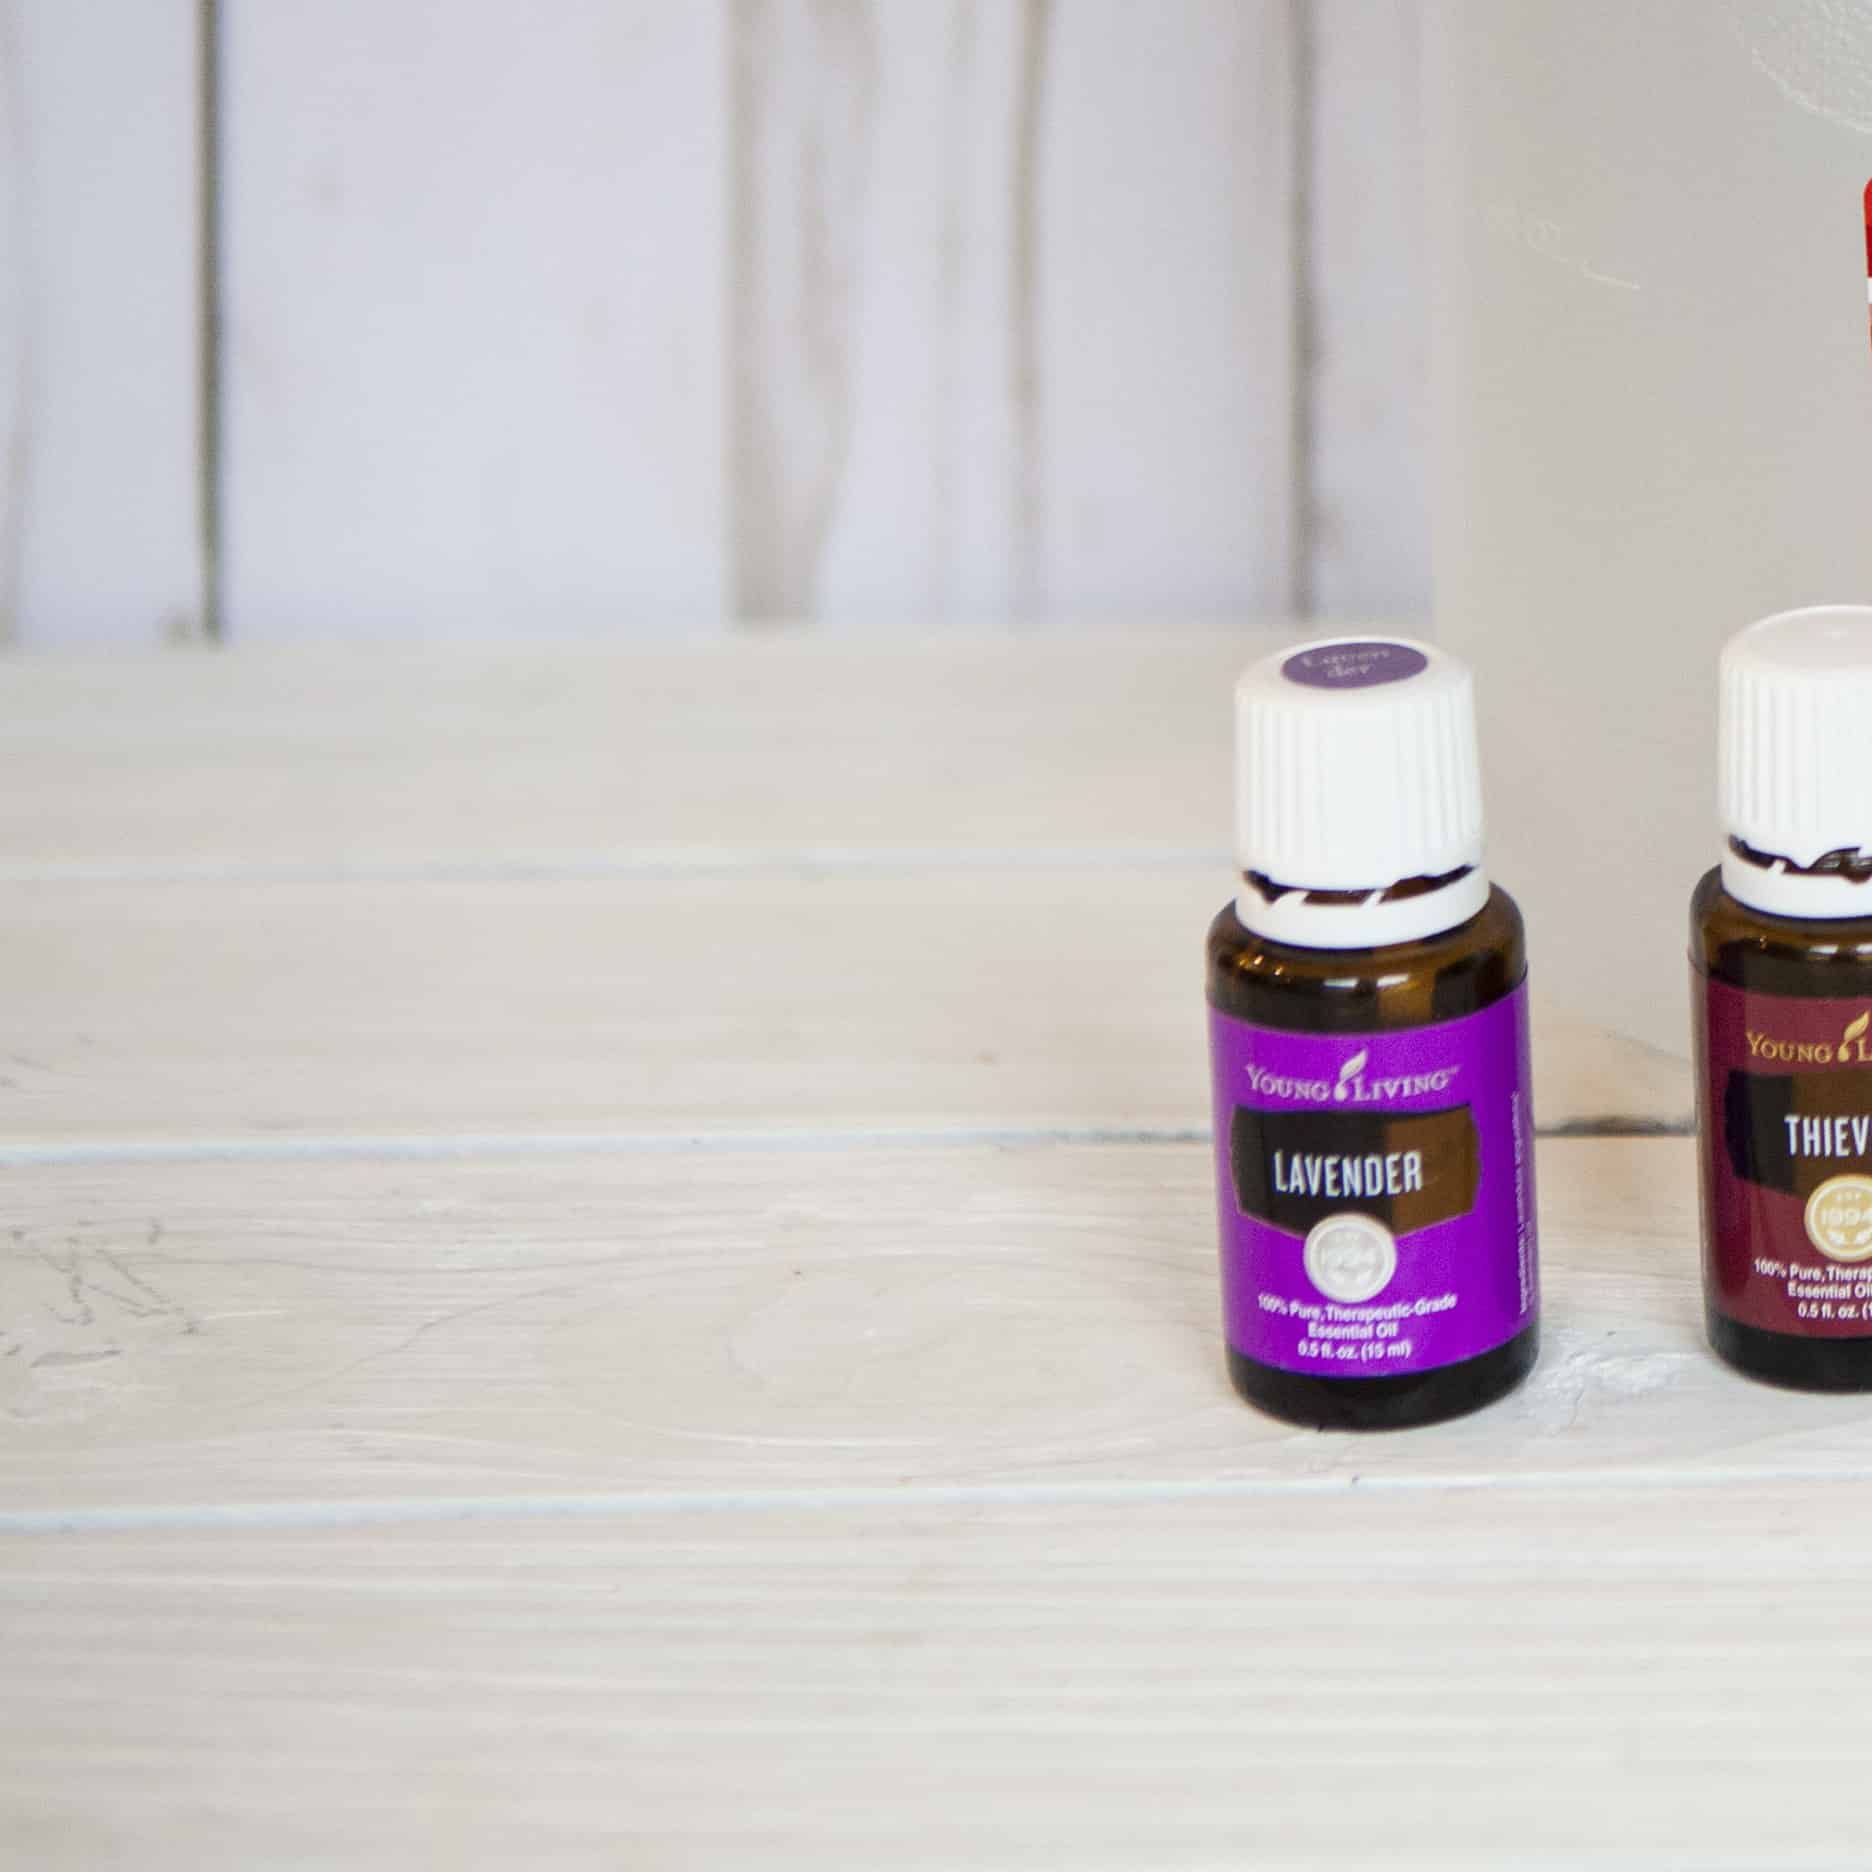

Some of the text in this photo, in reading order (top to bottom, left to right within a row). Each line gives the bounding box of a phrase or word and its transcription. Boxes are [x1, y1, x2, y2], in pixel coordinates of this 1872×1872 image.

[1273, 1149, 1424, 1198] LAVENDER
[1754, 1258, 1786, 1279] 100%
[1787, 1281, 1851, 1300] Essential
[1797, 1301, 1819, 1319] 0.5
[1307, 1321, 1399, 1340] Essential Oil
[1298, 1339, 1319, 1358] 0.5
